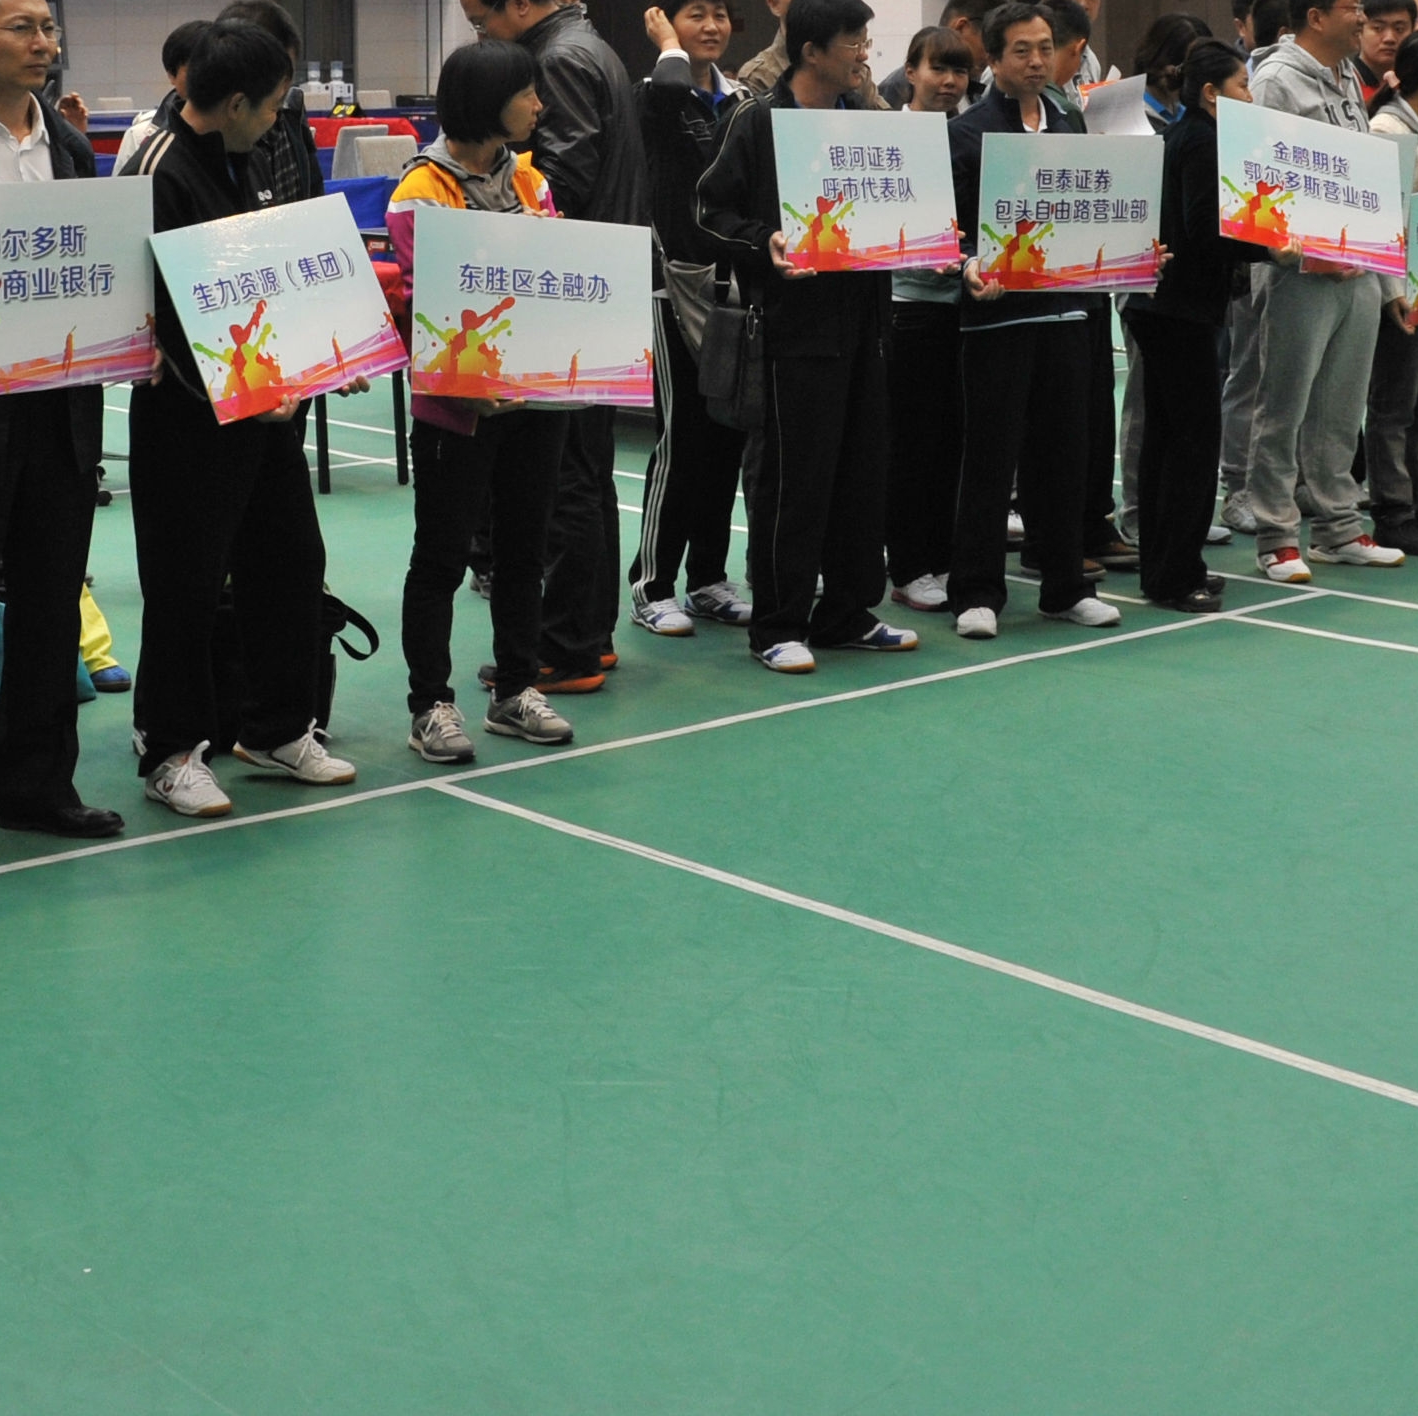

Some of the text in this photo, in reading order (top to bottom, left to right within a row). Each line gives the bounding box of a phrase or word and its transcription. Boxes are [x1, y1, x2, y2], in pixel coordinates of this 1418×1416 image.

[829, 145, 902, 168] 银河证券
[1272, 141, 1349, 176] 金鹏期货
[822, 177, 915, 200] 呼市代表队
[1036, 169, 1111, 190] 恒泰证券
[1244, 160, 1379, 210] 鄂尔多斯营业部
[995, 199, 1148, 221] 包头自由路营业部
[459, 263, 610, 300] 东胜区金融办
